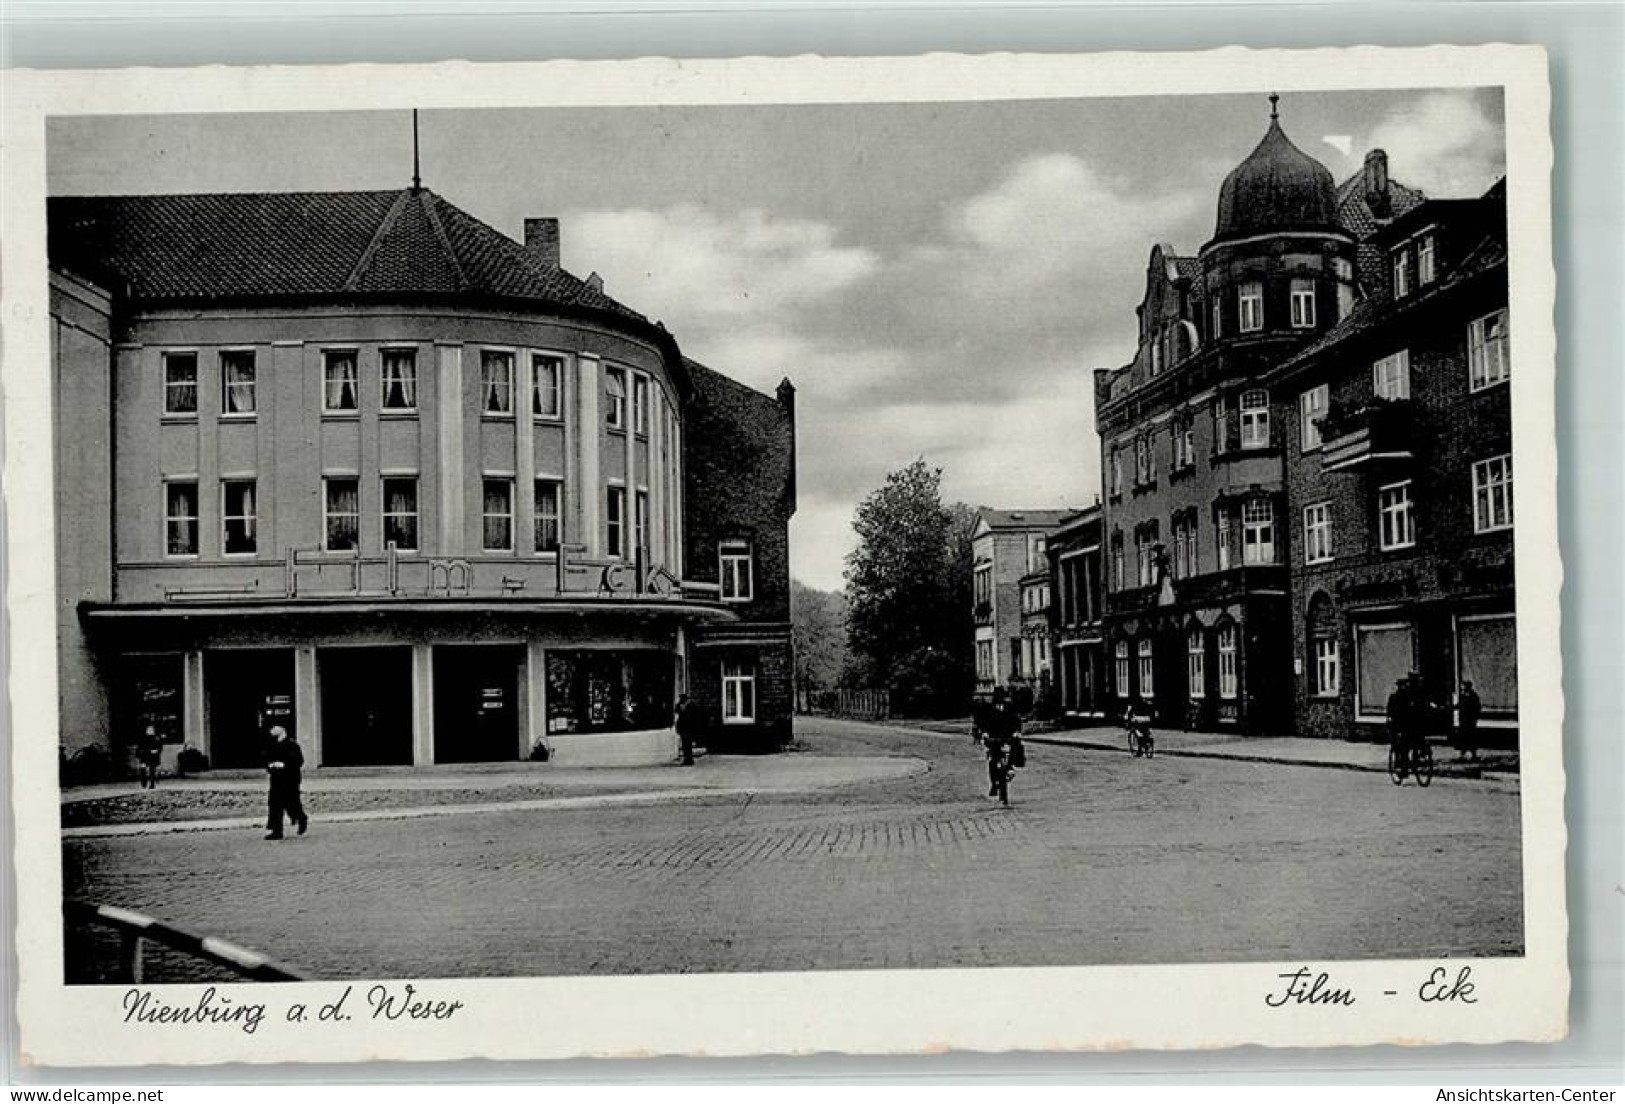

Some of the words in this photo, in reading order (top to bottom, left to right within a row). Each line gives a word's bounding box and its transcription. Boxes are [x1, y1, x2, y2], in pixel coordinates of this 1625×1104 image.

[286, 541, 474, 598] Film
[557, 542, 682, 599] Eck
[286, 1004, 308, 1023] a.
[318, 985, 352, 1022] d.
[367, 983, 465, 1020] Weser
[1266, 966, 1356, 1007] Film
[1419, 966, 1478, 1004] Eck
